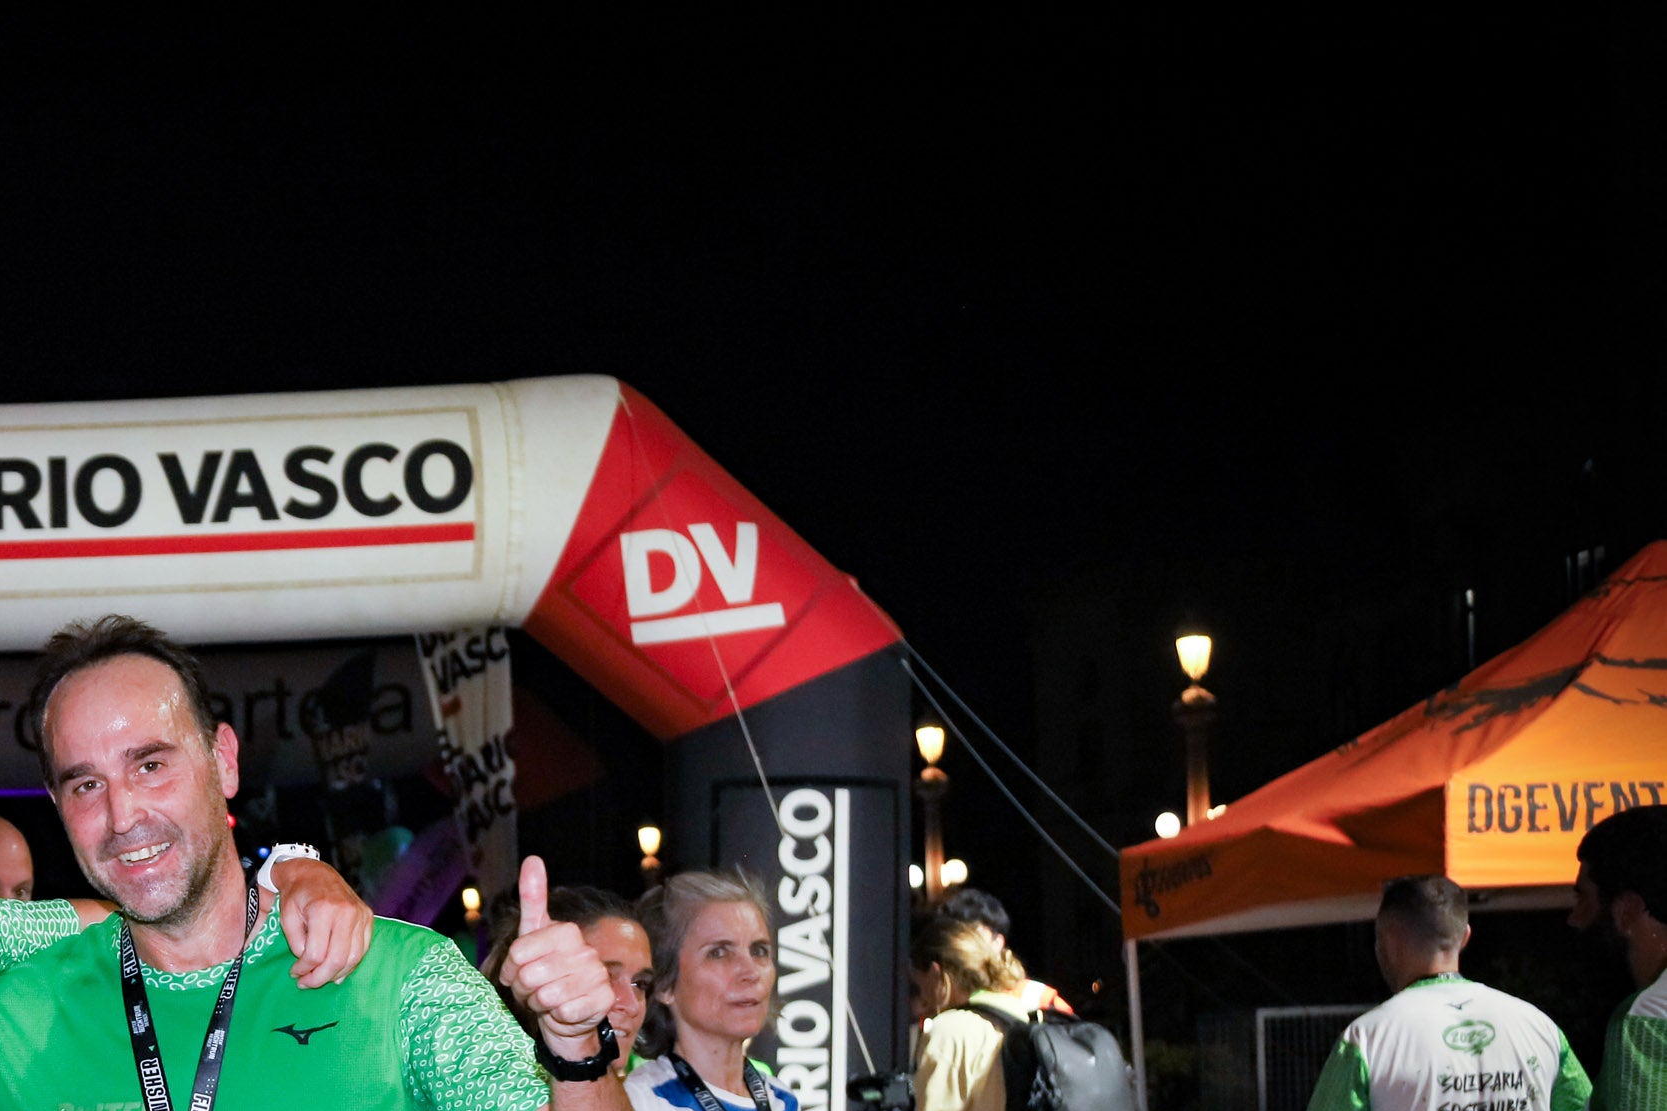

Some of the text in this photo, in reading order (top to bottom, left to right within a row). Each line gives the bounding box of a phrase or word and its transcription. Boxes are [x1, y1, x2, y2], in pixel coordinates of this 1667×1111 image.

[158, 438, 475, 525] VASCO
[620, 521, 758, 618] DV
[777, 787, 833, 996] VASCO
